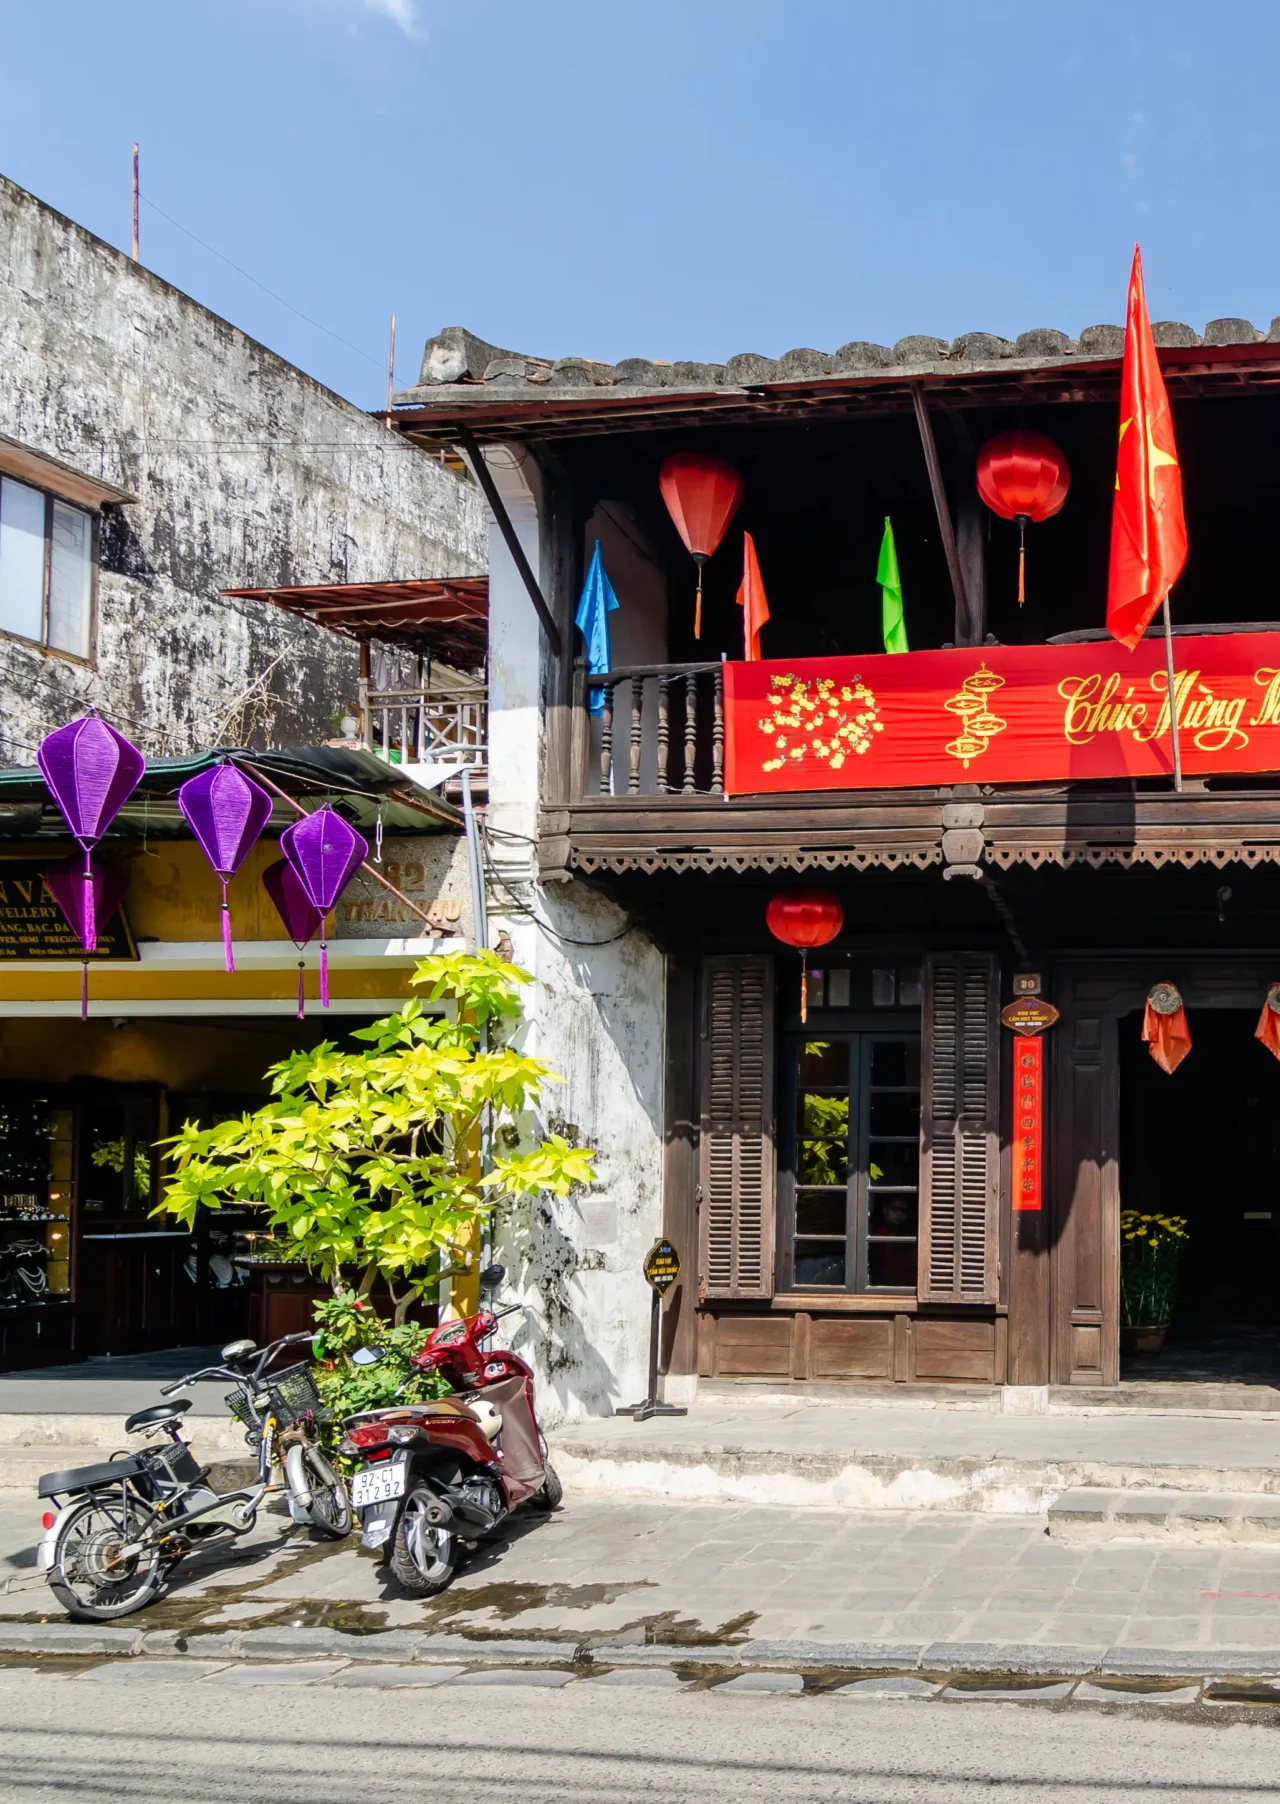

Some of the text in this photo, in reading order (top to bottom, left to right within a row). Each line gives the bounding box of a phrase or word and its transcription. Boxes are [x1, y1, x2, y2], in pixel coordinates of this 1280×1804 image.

[1057, 672, 1148, 745] Chúc
[1133, 669, 1249, 751] Mừng
[361, 1468, 394, 1488] 92-C1
[356, 1481, 400, 1504] 312.92
